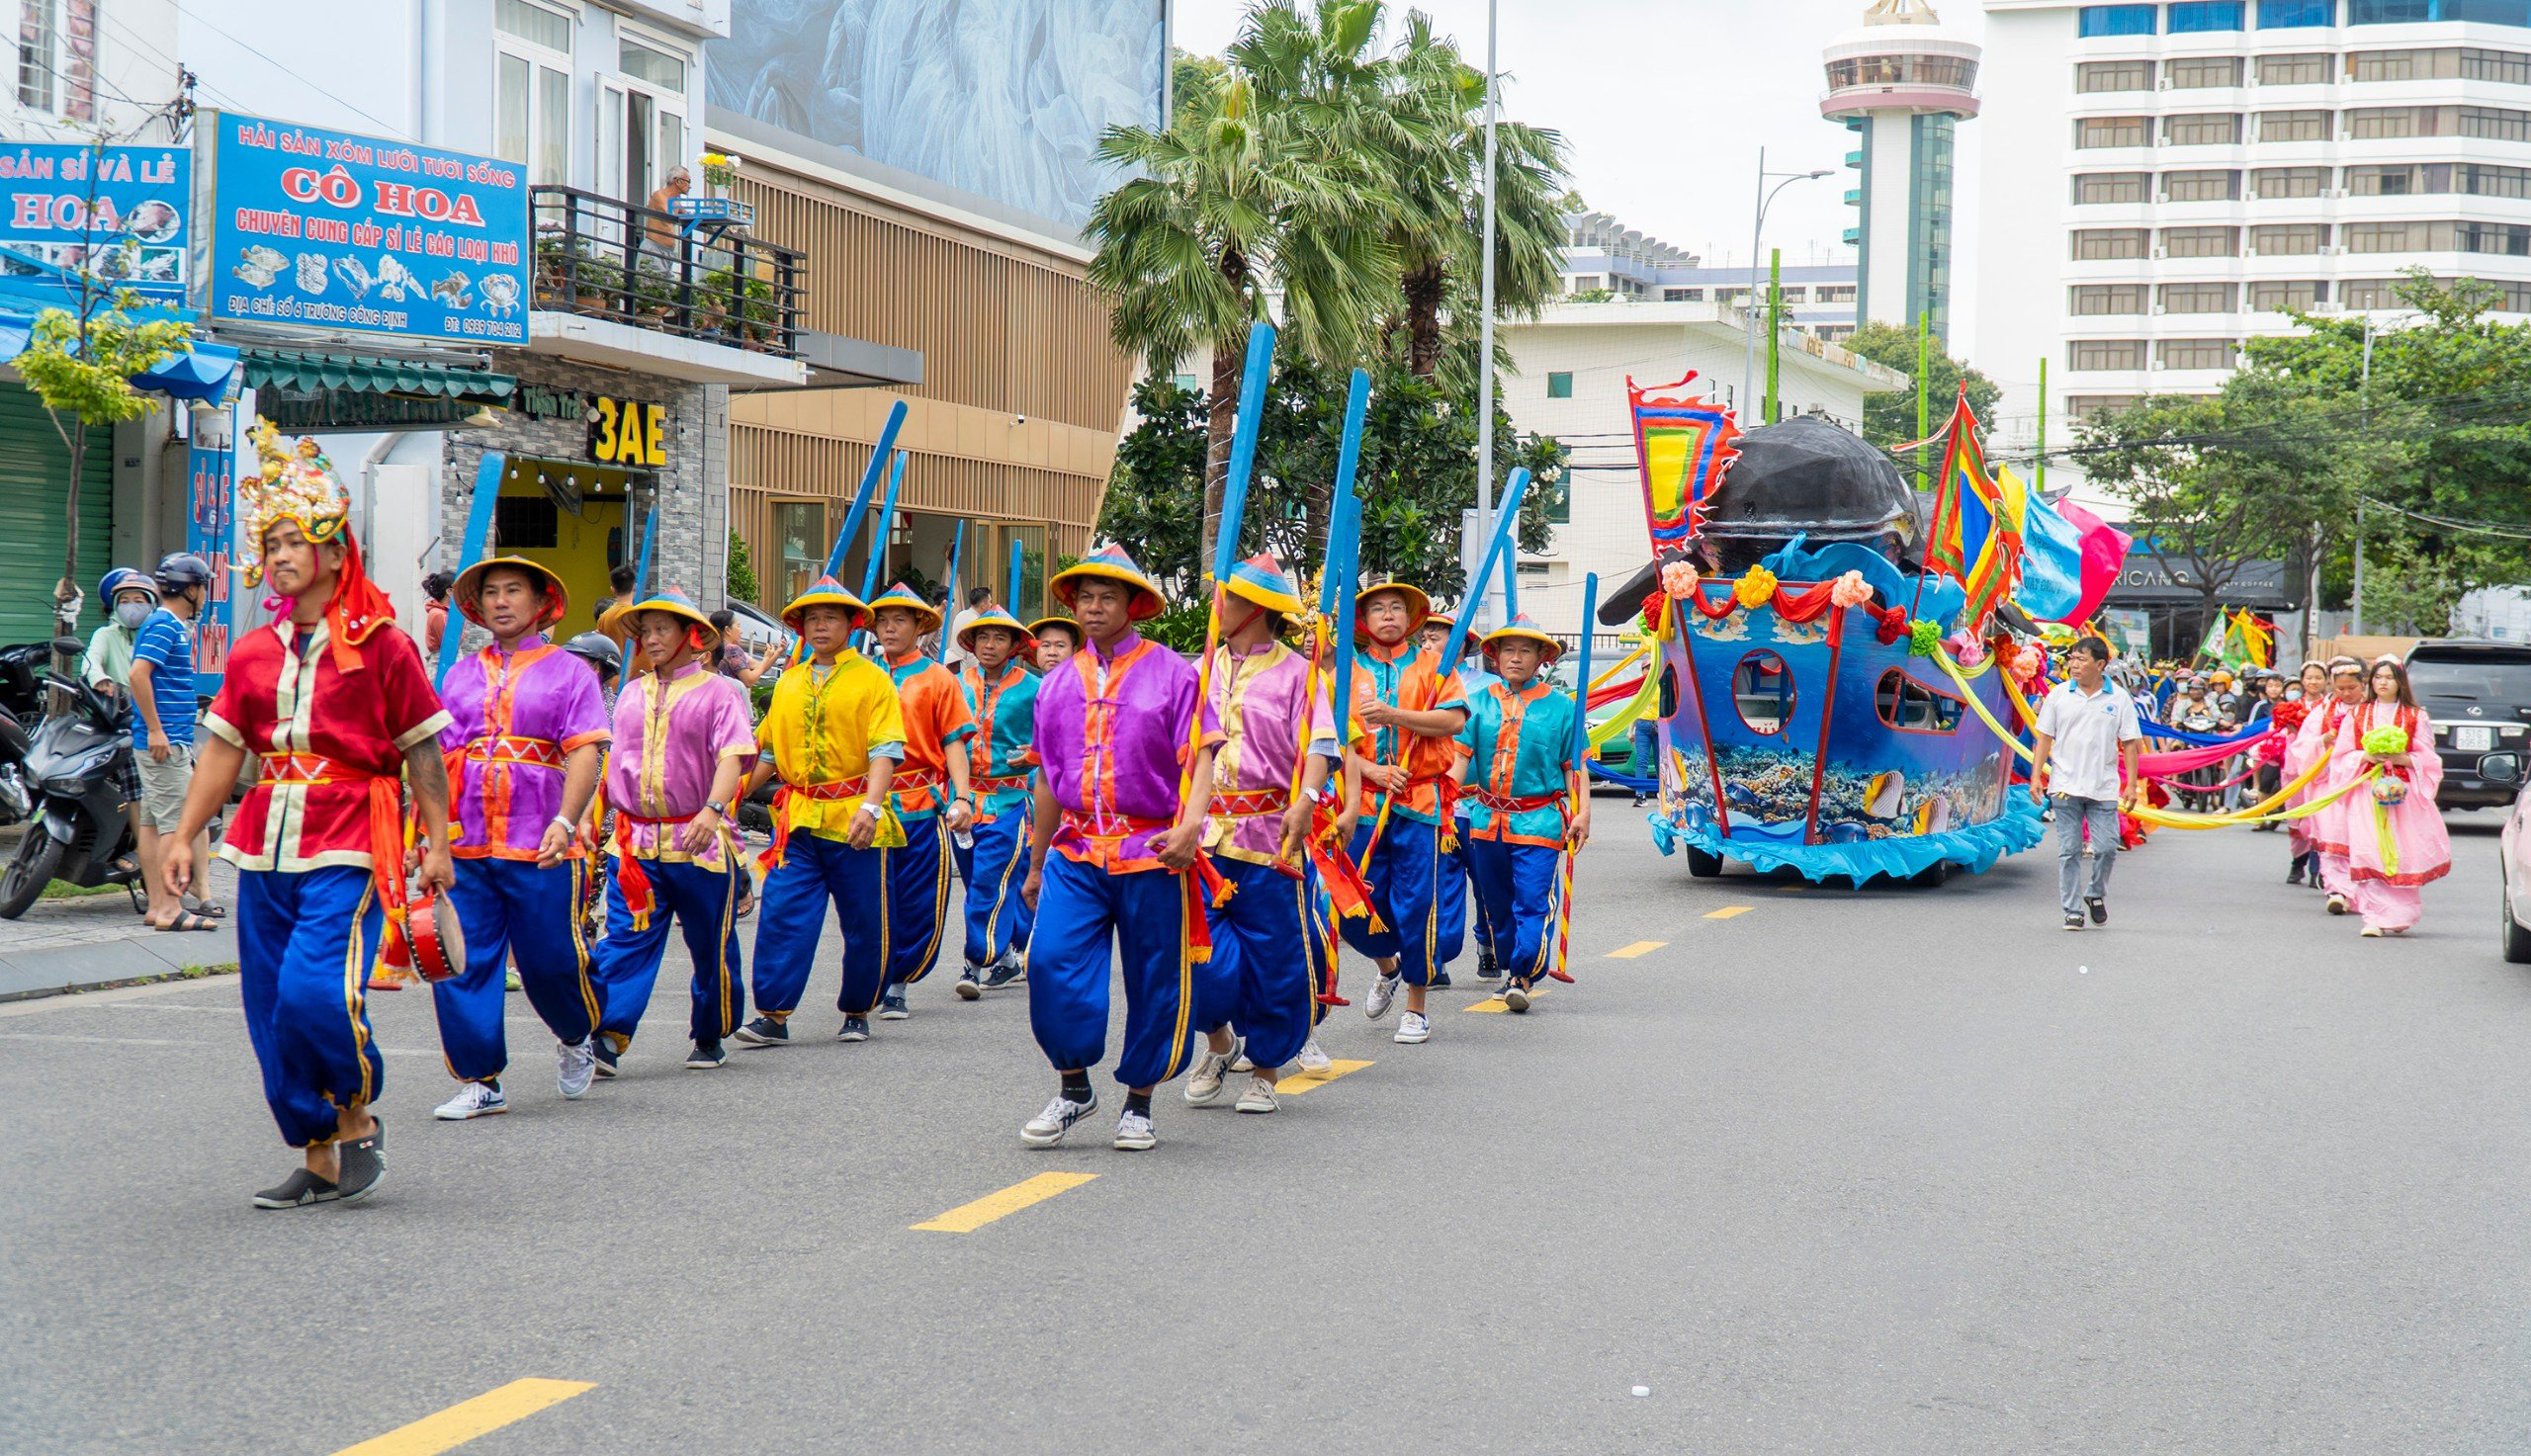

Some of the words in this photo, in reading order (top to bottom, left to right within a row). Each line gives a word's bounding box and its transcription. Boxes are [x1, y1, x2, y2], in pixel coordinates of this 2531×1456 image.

[0, 148, 54, 180] SẢN
[60, 148, 88, 181] SỈ
[97, 153, 133, 183] VÀ
[140, 152, 176, 184] LẺ
[238, 122, 276, 150] HẢI
[280, 128, 321, 157] SẢN
[325, 138, 373, 165] XÓM
[422, 155, 464, 180] TƯƠI
[467, 161, 516, 188] SỐNG
[10, 193, 121, 232] HOA
[281, 164, 362, 209] CÔ
[374, 180, 485, 227] HOA
[235, 208, 302, 238] CHUYÊN
[305, 216, 348, 244] CUNG
[352, 216, 384, 248] CẤP
[386, 222, 402, 251] SỈ
[405, 225, 422, 254] LẺ
[426, 230, 454, 257] CÁC
[458, 236, 488, 265] LOẠI
[491, 240, 519, 266] KHÔ
[228, 296, 249, 316] ĐỊA
[277, 296, 295, 316] SỐ
[295, 301, 303, 318] 6
[348, 304, 380, 325] CÔNG
[381, 310, 407, 330] ĐỊNH
[596, 396, 666, 466] 3AE
